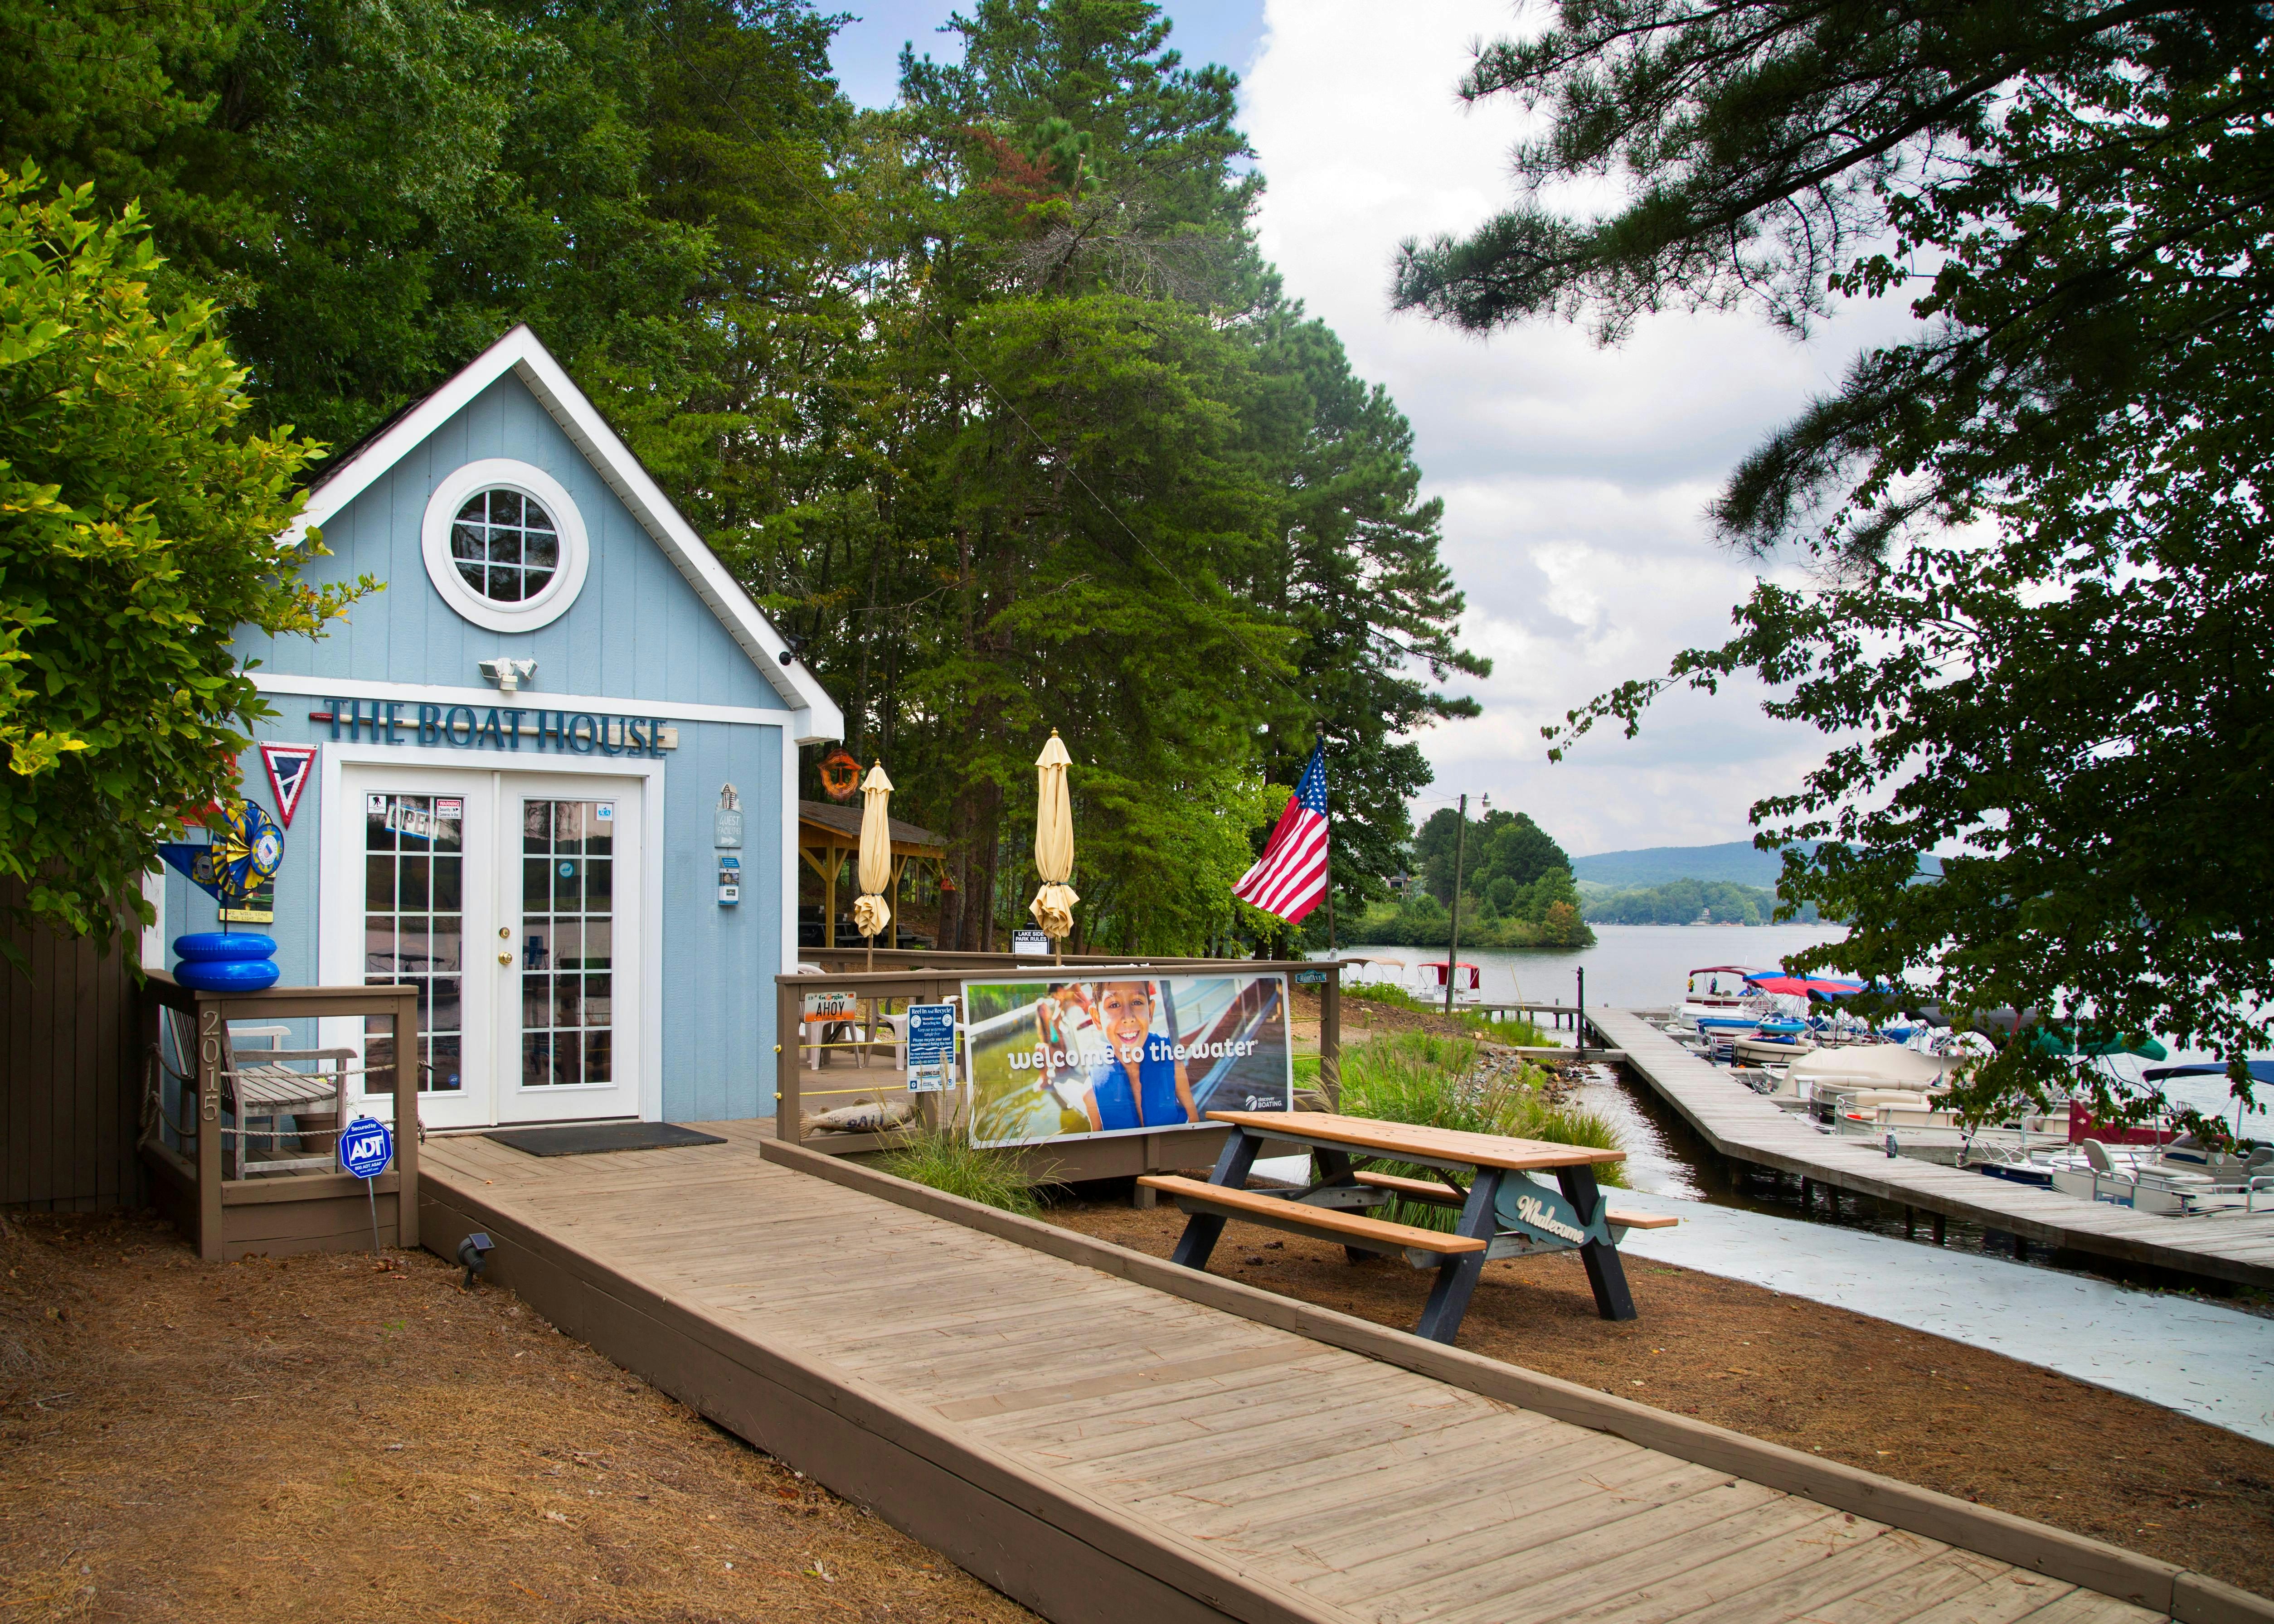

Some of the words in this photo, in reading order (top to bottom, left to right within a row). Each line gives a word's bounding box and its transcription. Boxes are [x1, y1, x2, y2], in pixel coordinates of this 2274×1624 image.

[324, 698, 405, 742] THE
[418, 704, 526, 748] BOAT
[538, 710, 667, 756] HOUSE
[718, 826, 742, 835] FACILITIES
[719, 815, 740, 826] GUEST
[816, 1001, 845, 1016] AHOY
[202, 1011, 220, 1120] 2015
[1007, 1046, 1115, 1070] welcome
[1120, 1044, 1145, 1064] to
[1150, 1040, 1186, 1062] the
[1516, 1195, 1584, 1244] Whalecome
